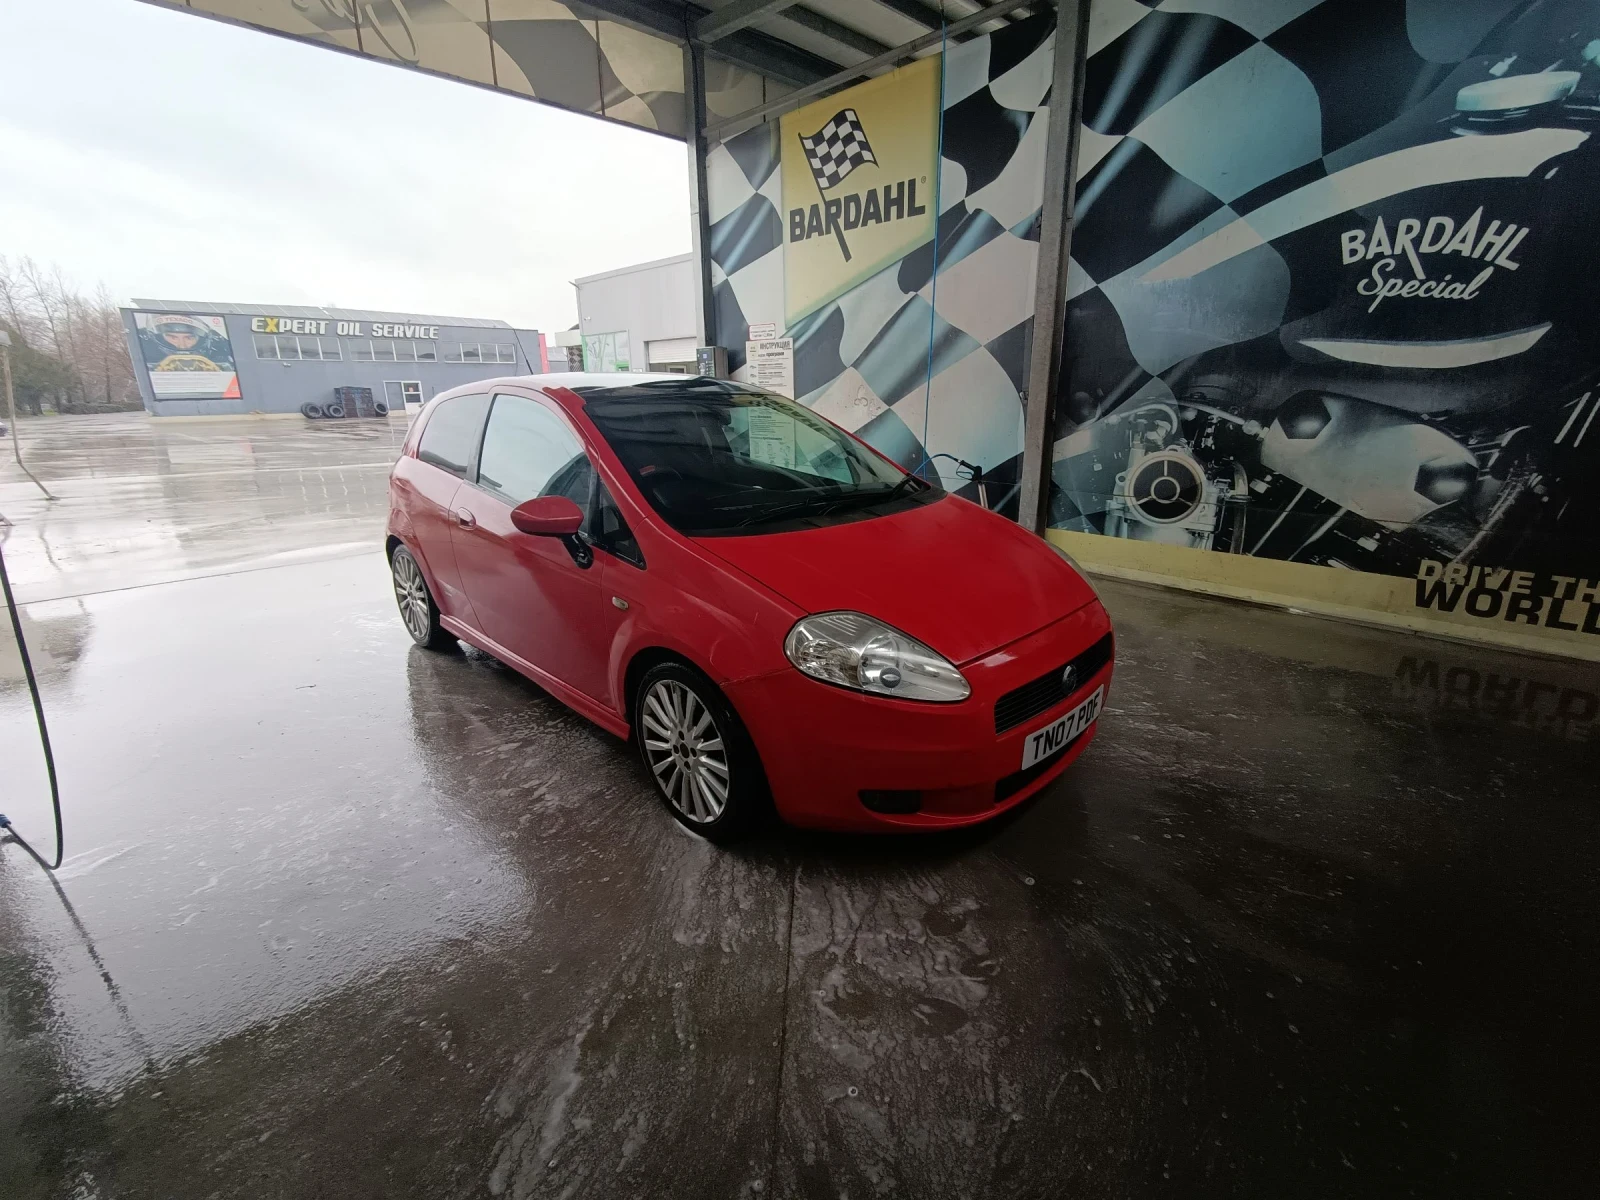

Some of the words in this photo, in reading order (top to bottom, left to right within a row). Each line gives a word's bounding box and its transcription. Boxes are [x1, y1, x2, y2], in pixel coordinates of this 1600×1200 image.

[789, 177, 926, 263] BARDAHL
[1340, 205, 1530, 280] BARDAHL
[1356, 257, 1495, 314] Special
[251, 317, 330, 336] EXPERT
[336, 320, 365, 337] OIL
[371, 323, 440, 340] SERVICE
[1416, 559, 1536, 595] DRIVE
[1032, 713, 1076, 761] TN07
[1075, 692, 1101, 733] PDF
